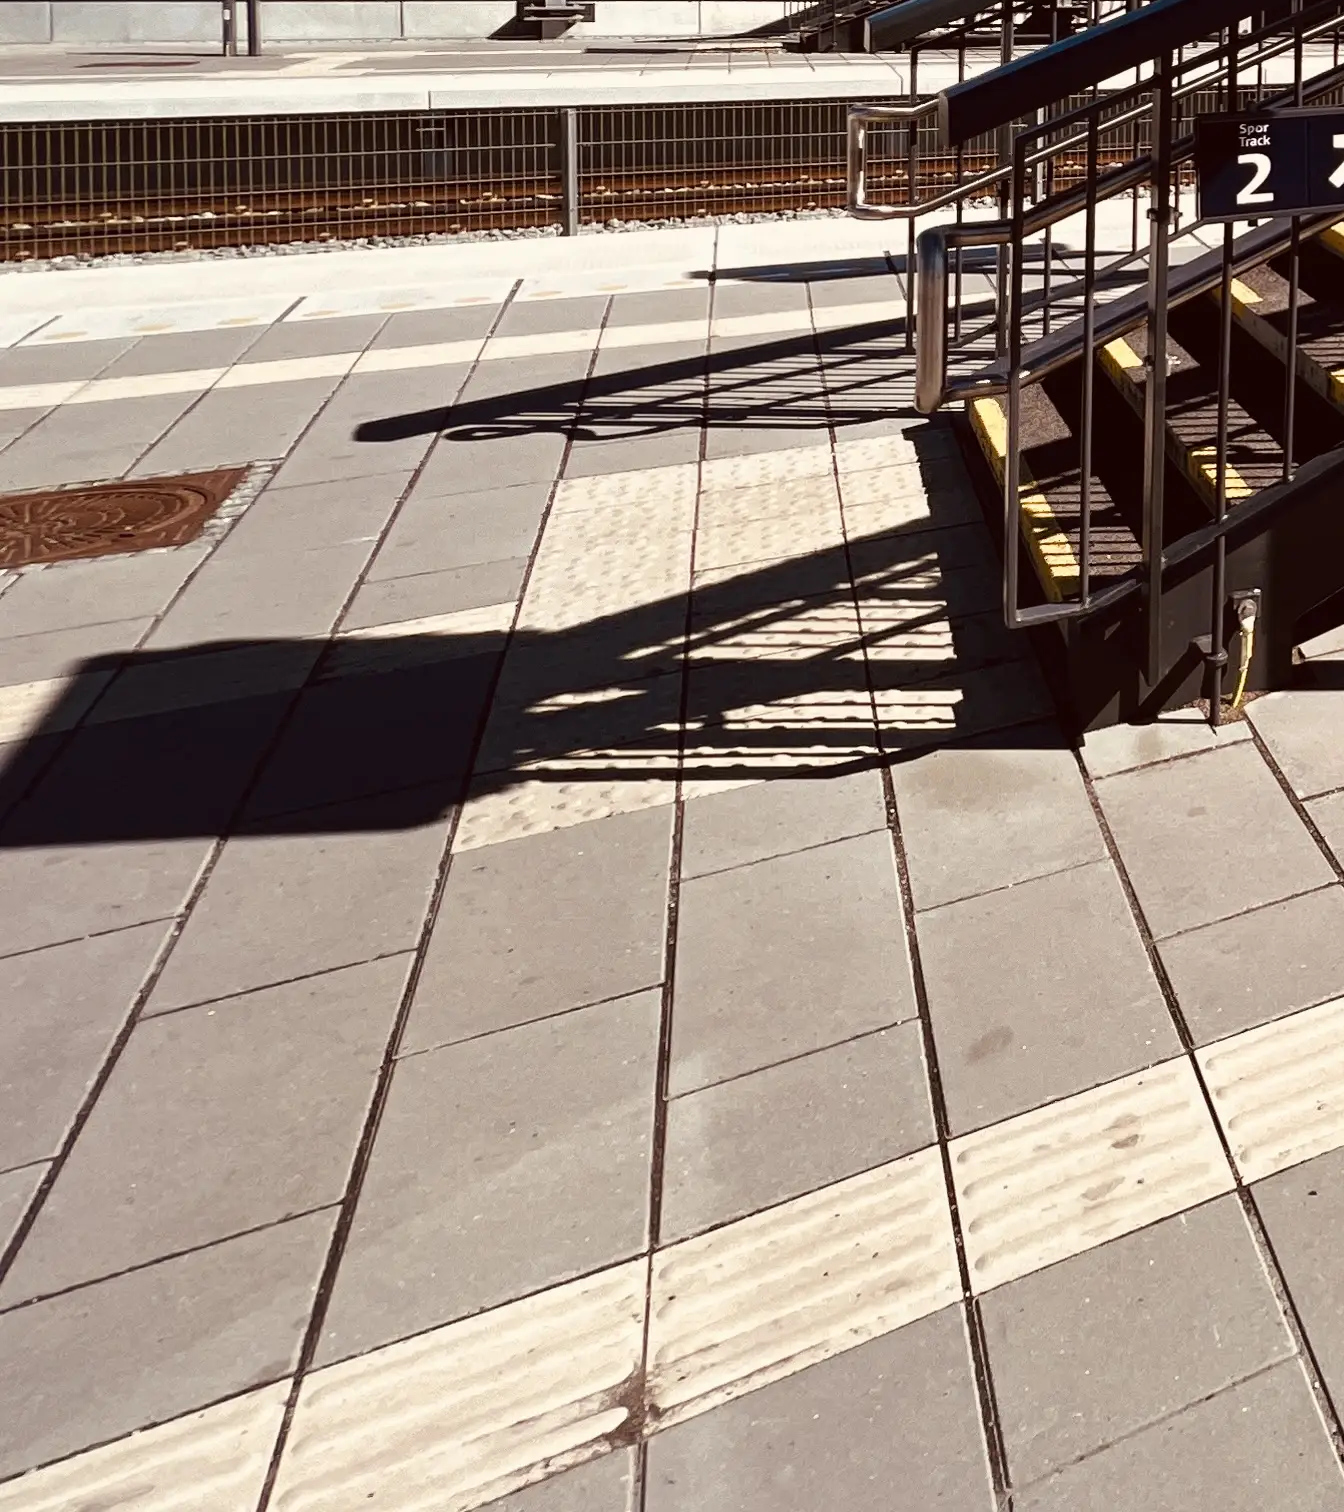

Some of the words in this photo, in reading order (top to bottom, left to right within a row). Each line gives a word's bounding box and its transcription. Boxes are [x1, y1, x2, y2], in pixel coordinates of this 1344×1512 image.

[1239, 123, 1270, 136] Spor
[1239, 134, 1271, 148] Track
[1236, 152, 1275, 205] 2
